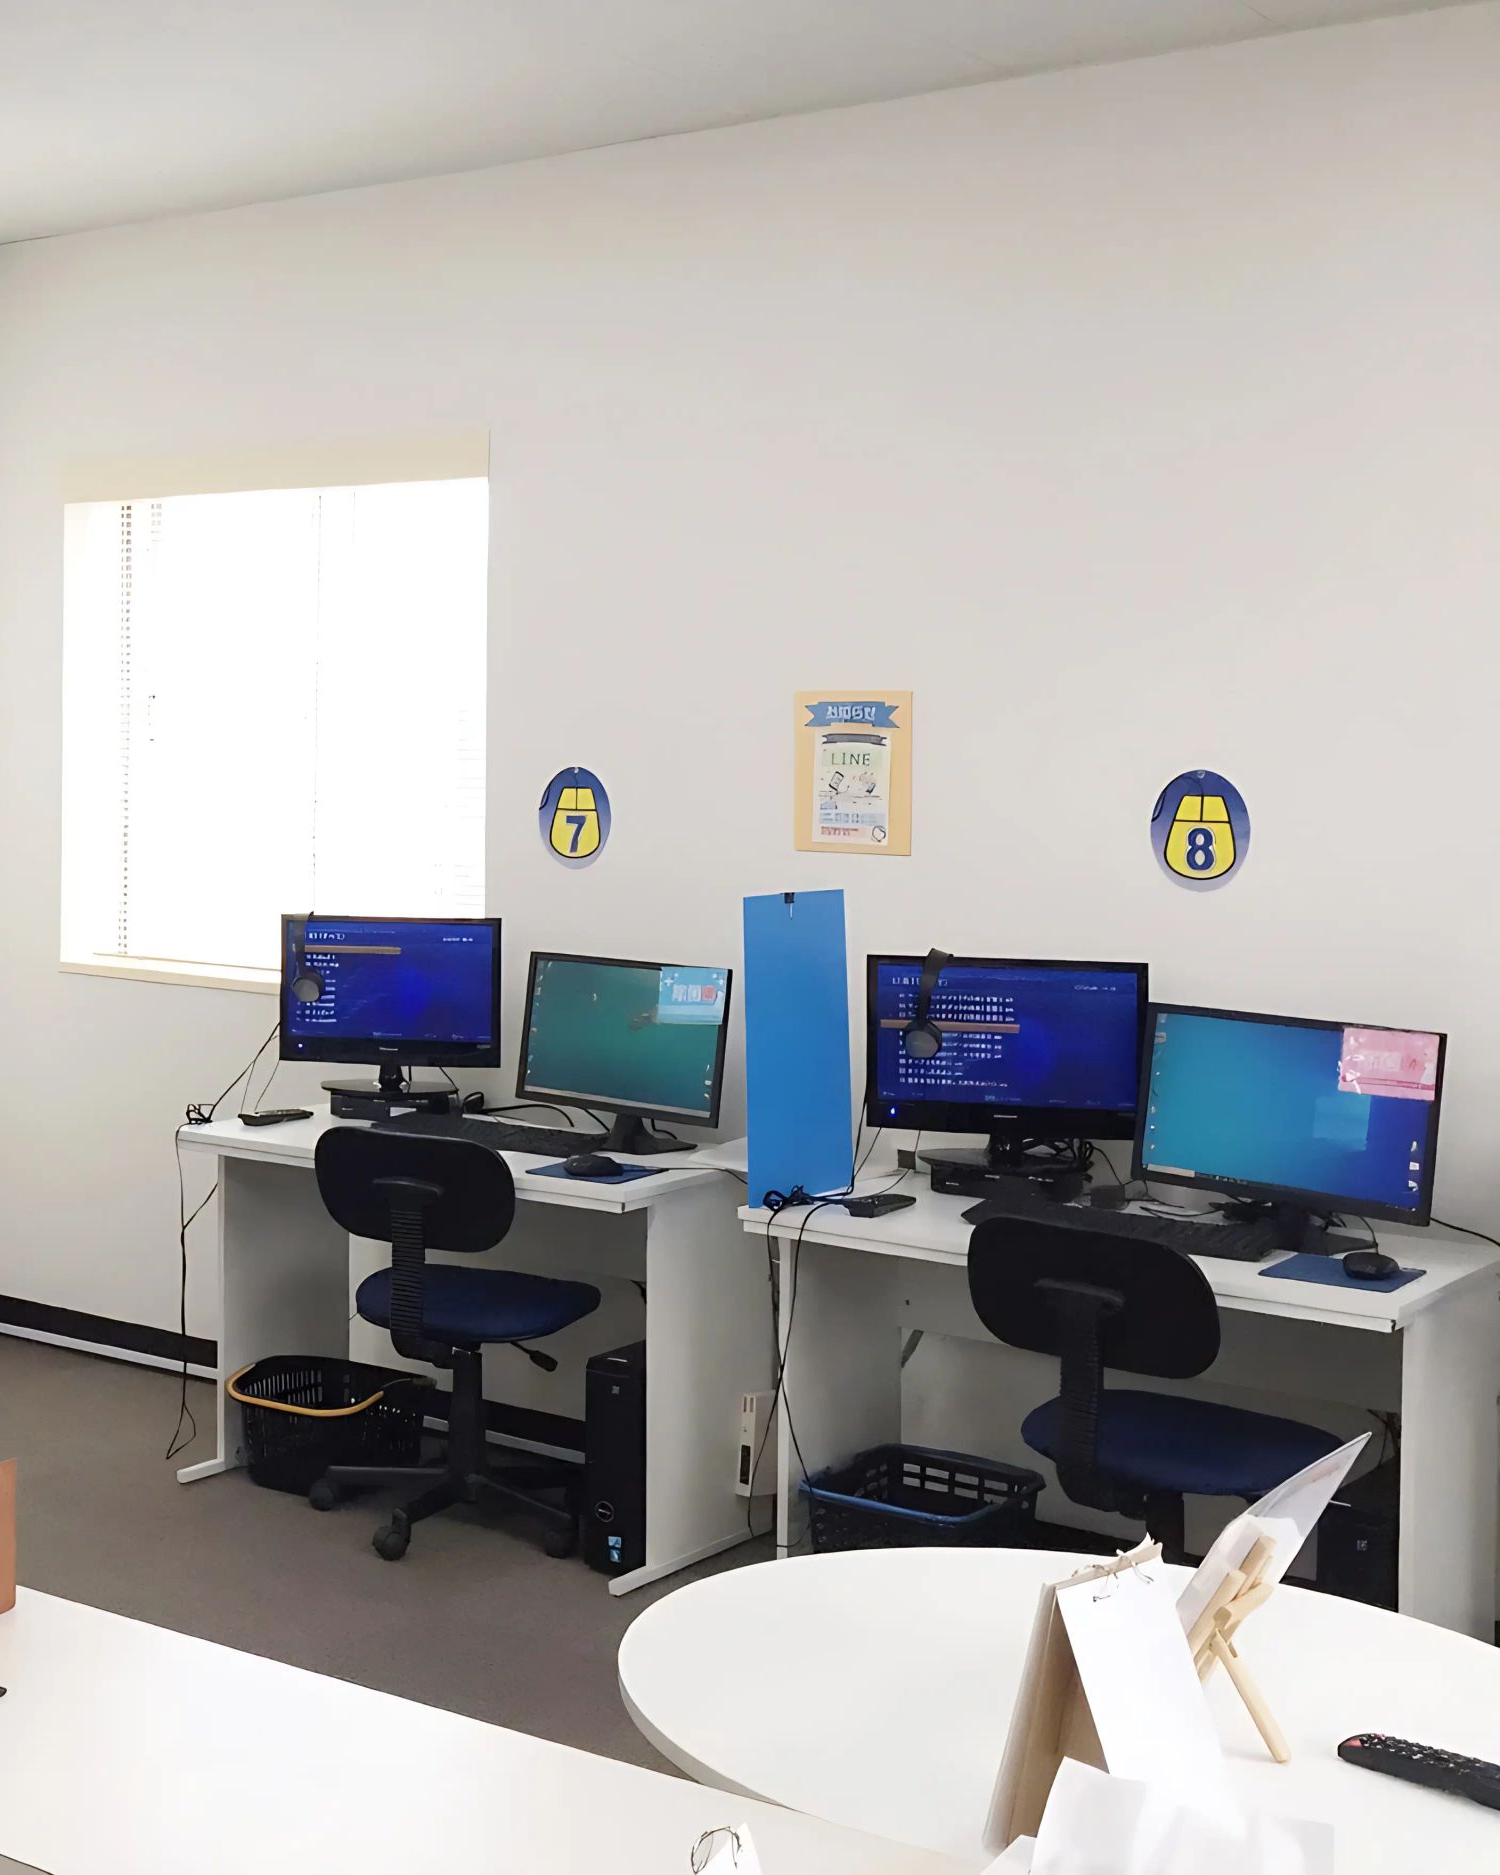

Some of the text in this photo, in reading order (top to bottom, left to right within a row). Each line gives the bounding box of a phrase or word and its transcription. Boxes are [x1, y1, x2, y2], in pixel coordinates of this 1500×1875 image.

[831, 752, 871, 767] LINE
[565, 815, 587, 853] 7
[1185, 827, 1216, 871] 8
